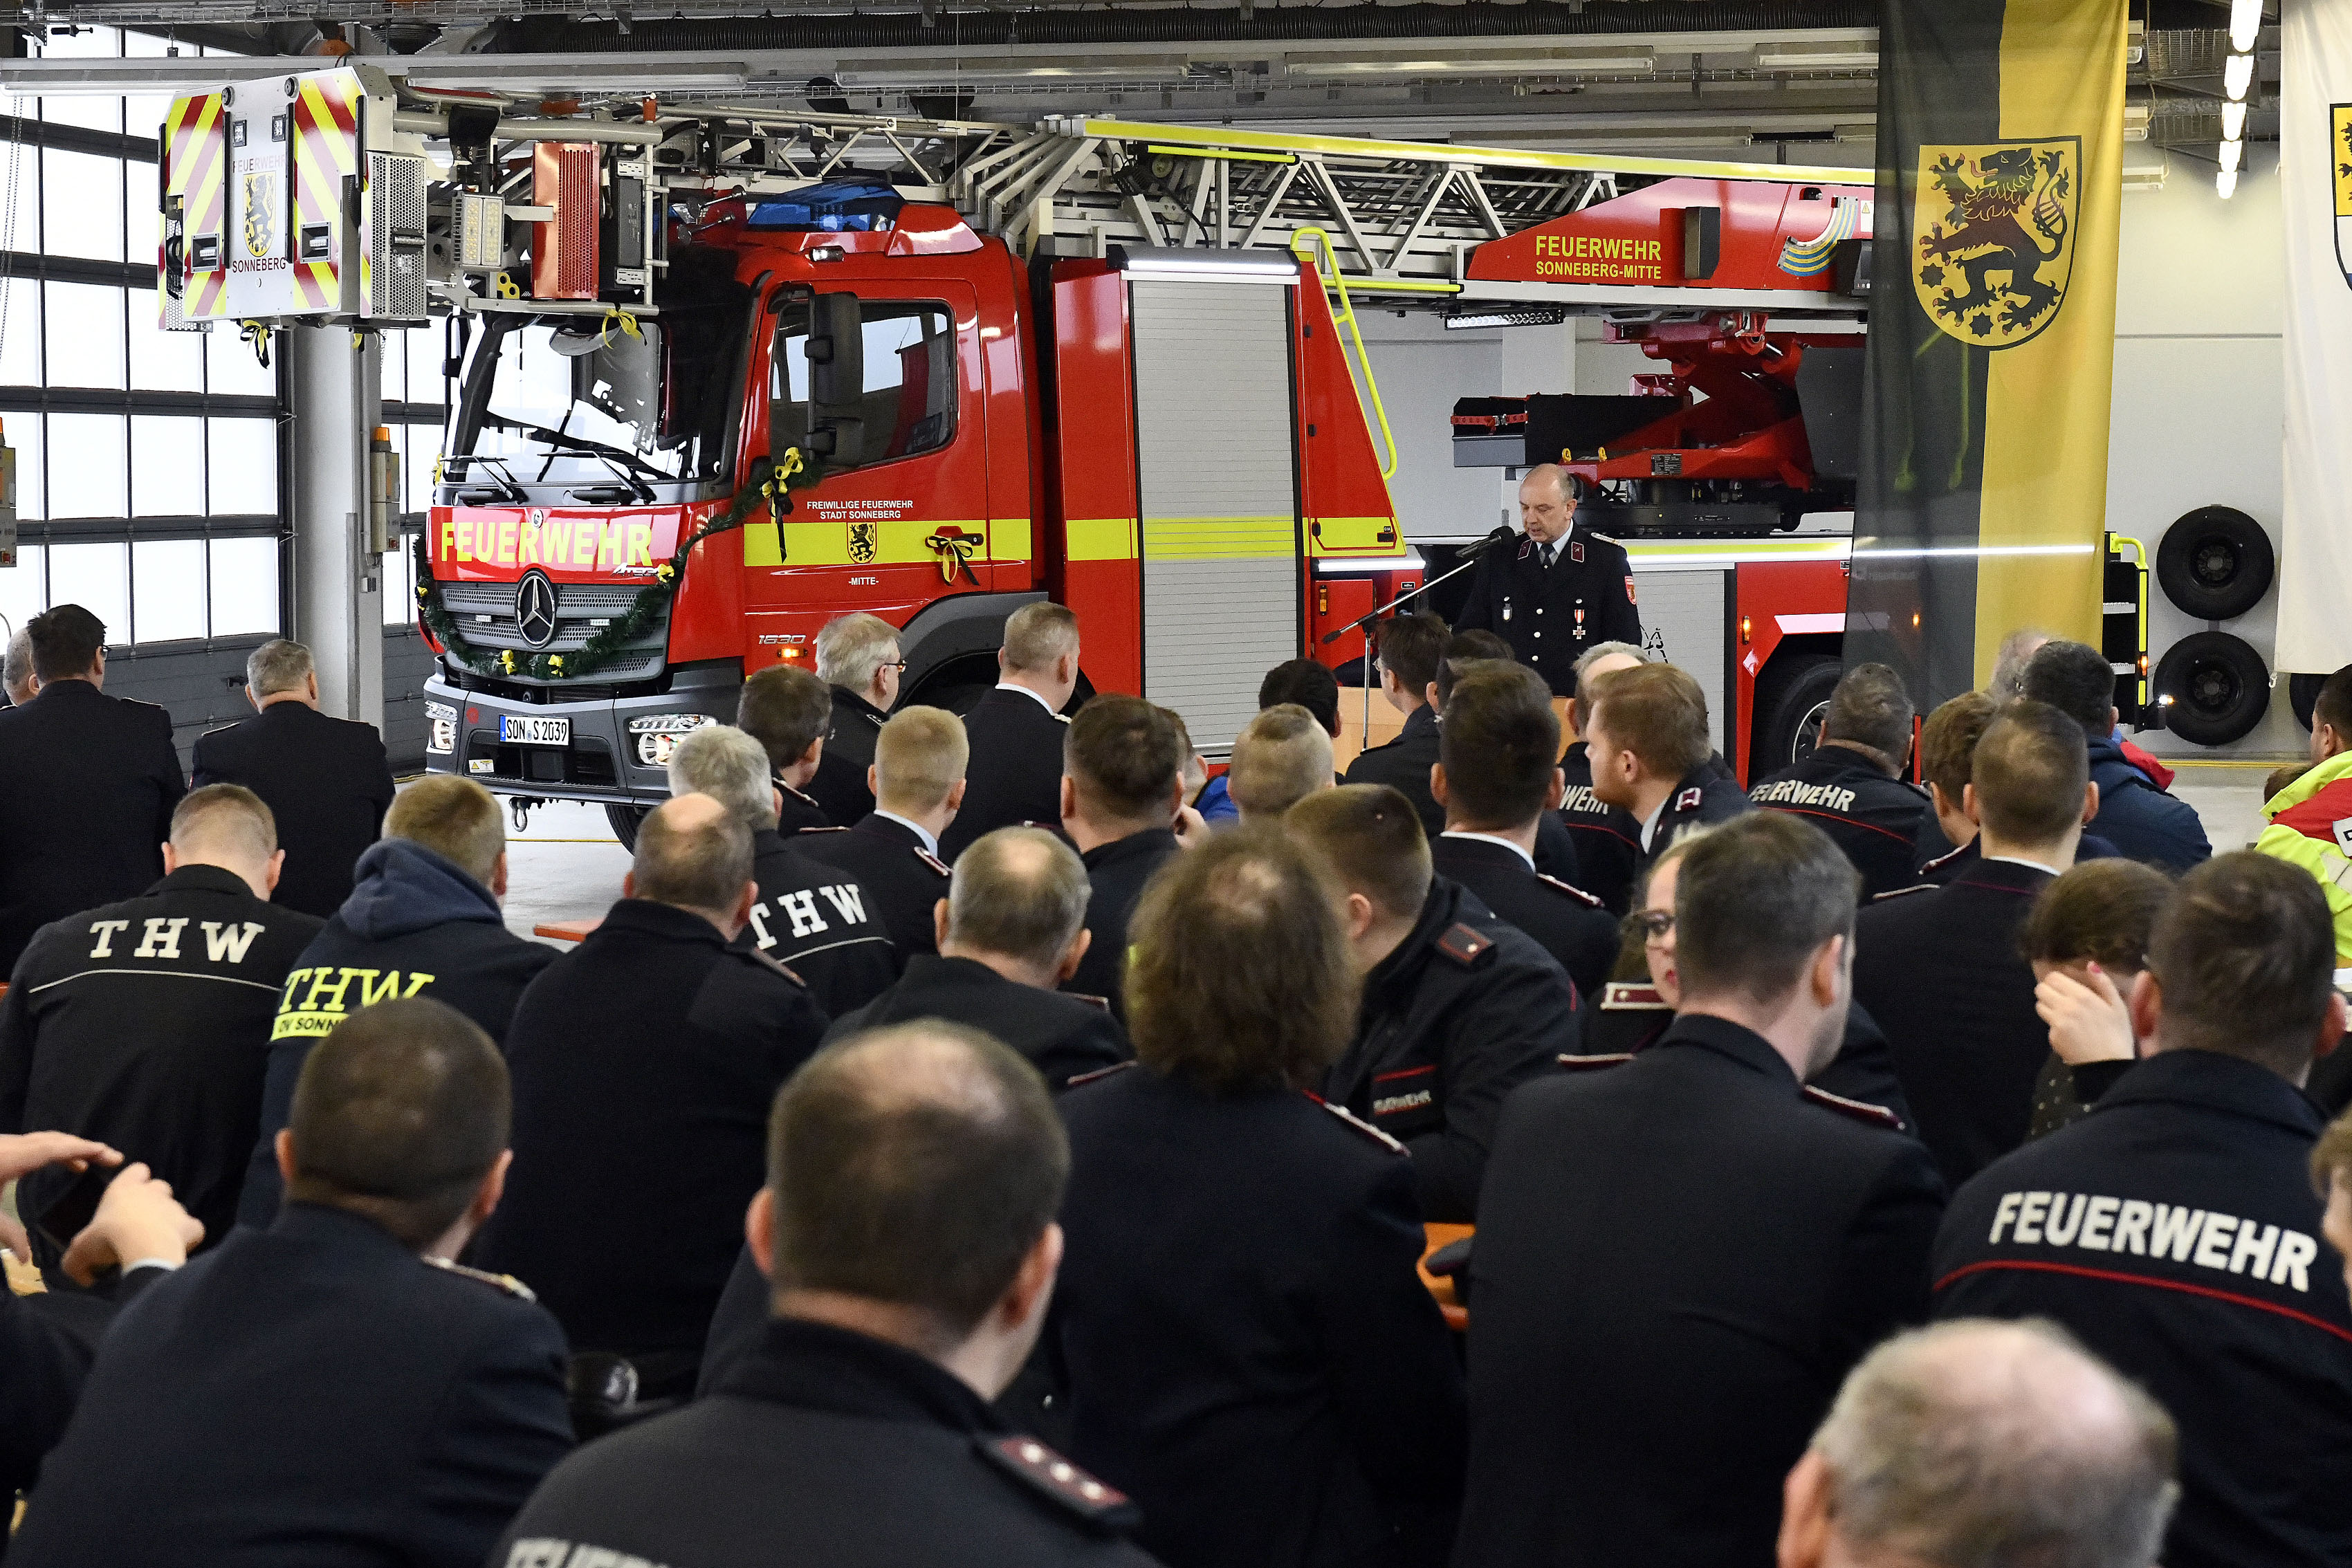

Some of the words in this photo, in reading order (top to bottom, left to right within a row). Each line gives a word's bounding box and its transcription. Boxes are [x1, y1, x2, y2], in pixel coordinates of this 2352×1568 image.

[1536, 235, 1662, 261] FEUERWEHR
[232, 257, 286, 273] SONNEBERG
[1536, 261, 1662, 279] SONNEBERG-MITTE
[807, 501, 860, 510] FREIWILLIGE
[861, 500, 914, 508] FEUERWEHR
[820, 511, 847, 519] STADT
[849, 510, 901, 519] SONNEBERG
[441, 522, 653, 566] FEUERWEHR
[758, 634, 807, 645] 1630
[506, 719, 526, 740] SON
[533, 721, 539, 740] S
[542, 721, 567, 742] 2039
[749, 883, 867, 950] THW
[89, 917, 266, 963] THW
[278, 966, 436, 1015] THW
[295, 1017, 336, 1031] SONN
[1989, 1190, 2318, 1293] FEUERWEHR
